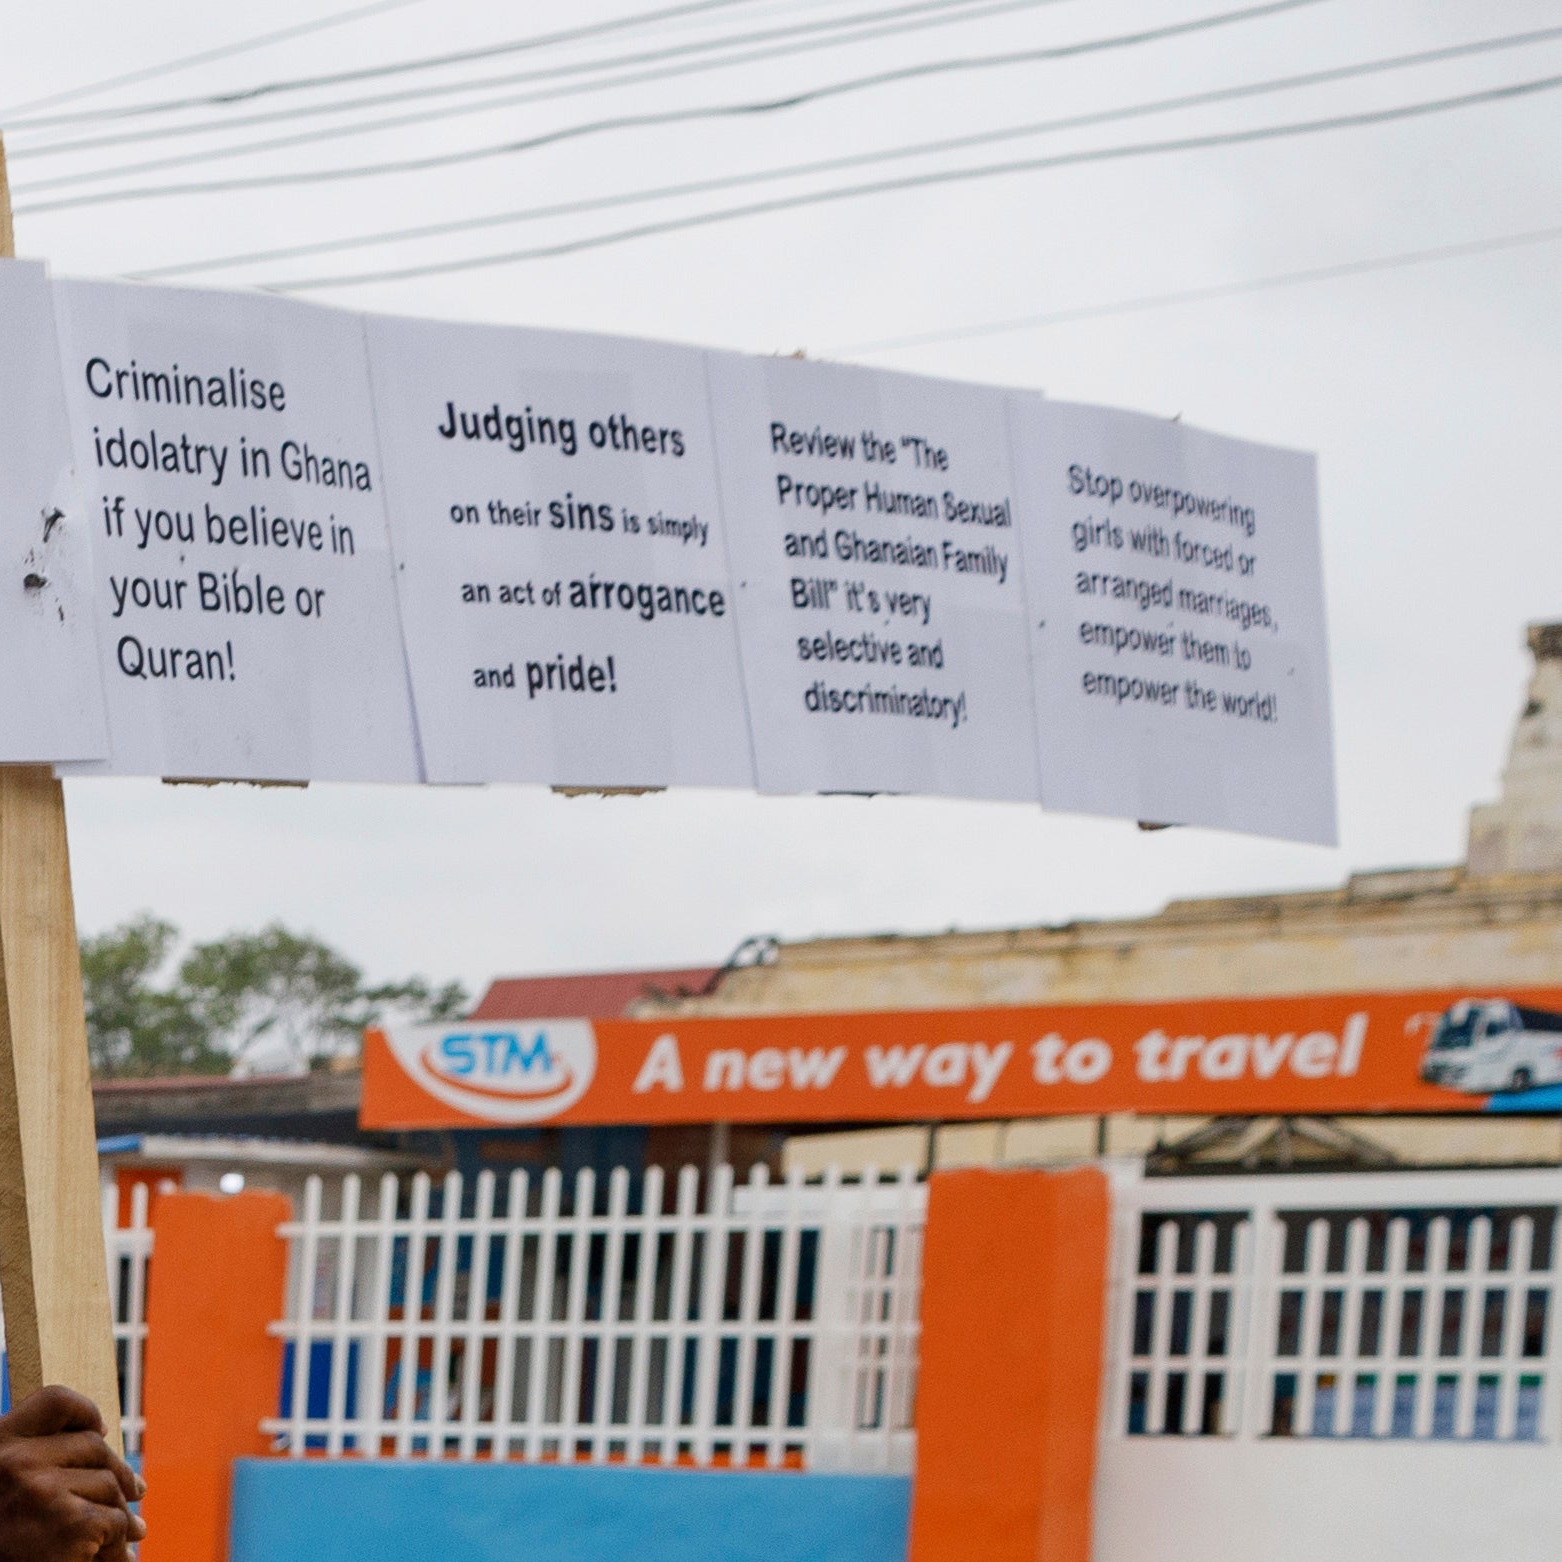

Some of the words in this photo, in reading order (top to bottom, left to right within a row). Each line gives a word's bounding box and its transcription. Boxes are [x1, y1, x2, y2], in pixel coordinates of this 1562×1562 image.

[85, 357, 286, 412] Criminalise
[438, 401, 578, 457] Judging
[588, 414, 685, 458] others
[770, 422, 855, 459] Review
[860, 432, 897, 465] the
[93, 426, 228, 487] idolatry
[240, 436, 271, 478] in
[280, 440, 372, 491] Ghana
[450, 505, 480, 524] on
[487, 500, 541, 527] their
[548, 492, 615, 532] sins
[621, 508, 641, 535] is
[647, 516, 708, 547] simply
[776, 473, 858, 514] Proper
[864, 481, 938, 518] Human
[942, 491, 1011, 527] Sexual
[1068, 464, 1124, 505] Stop
[1128, 480, 1256, 538] overpowering
[102, 495, 125, 537] if
[134, 508, 195, 550] you
[204, 503, 323, 551] believe
[330, 514, 355, 556] in
[1072, 519, 1124, 553] girls
[1130, 528, 1170, 557] with
[1173, 531, 1234, 572] forced
[1237, 554, 1256, 576] or
[784, 529, 829, 559] and
[834, 529, 940, 567] Ghanaian
[941, 540, 1008, 585] Family
[109, 576, 188, 618] your
[197, 568, 285, 615] Bible
[295, 587, 325, 618] or
[461, 584, 491, 603] an
[499, 581, 536, 605] act
[541, 581, 561, 607] of
[569, 578, 725, 622] arrogance
[885, 592, 931, 626] very
[1076, 571, 1173, 611] arranged
[117, 635, 235, 681] Quran!
[797, 630, 902, 665] selective
[907, 643, 944, 670] and
[1079, 622, 1176, 656] empower
[1181, 632, 1230, 665] them
[1233, 642, 1252, 672] to
[473, 663, 516, 689] and
[526, 653, 617, 699] pride!
[1082, 671, 1180, 705] empower
[1184, 681, 1217, 712] the
[441, 1031, 552, 1075] STM
[633, 1033, 684, 1094] A
[703, 1046, 847, 1092] new
[863, 1041, 1014, 1103] way
[1030, 1032, 1114, 1084] to
[1133, 1011, 1369, 1083] travel
